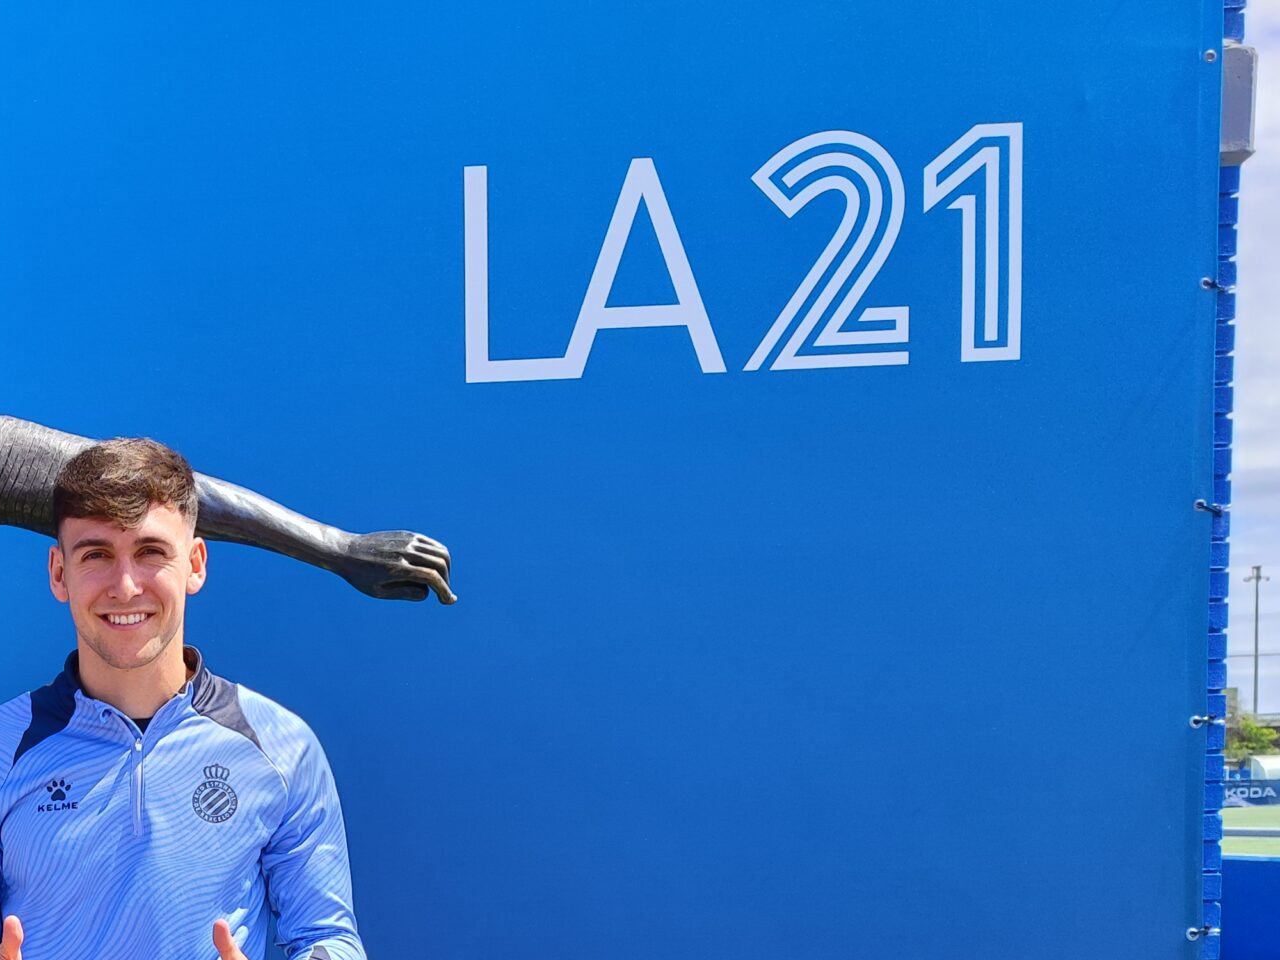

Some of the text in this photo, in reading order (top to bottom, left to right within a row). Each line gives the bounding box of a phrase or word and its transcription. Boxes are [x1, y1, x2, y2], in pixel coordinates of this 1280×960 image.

[463, 121, 1024, 384] LA 21
[1224, 786, 1277, 799] KODA
[37, 801, 78, 812] KELME
